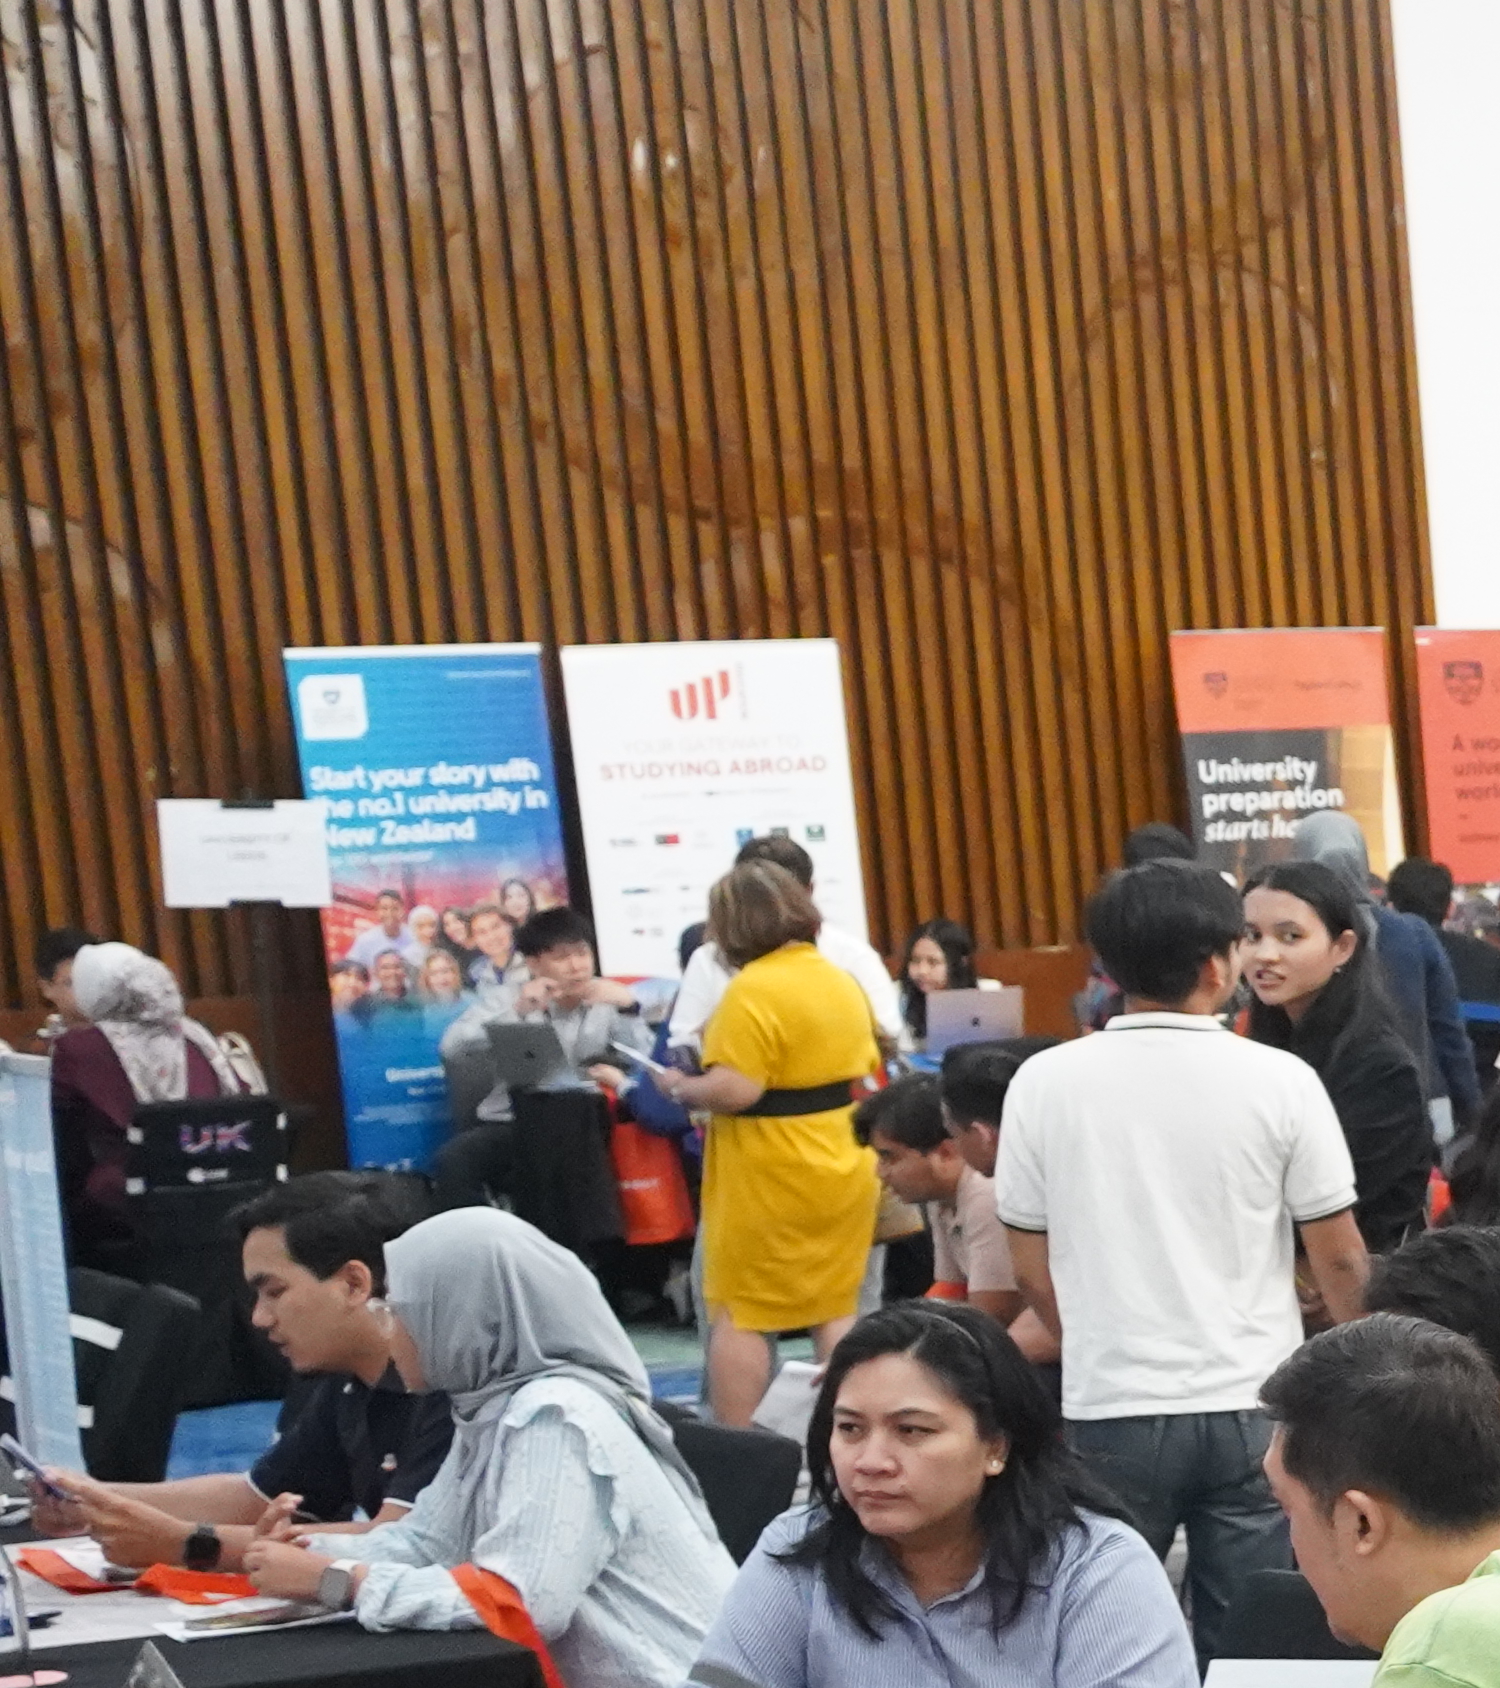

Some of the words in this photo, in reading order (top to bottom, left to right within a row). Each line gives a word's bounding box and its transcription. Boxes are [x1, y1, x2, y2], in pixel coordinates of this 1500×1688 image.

[668, 670, 731, 721] UP
[1453, 734, 1464, 751] A
[309, 765, 366, 791] Start
[369, 766, 425, 792] your
[429, 761, 486, 788] story
[488, 757, 540, 782] with
[599, 759, 721, 782] STUDYING
[728, 754, 829, 776] ABROAD
[1198, 755, 1318, 785] University
[357, 792, 404, 818] no.1
[408, 787, 522, 815] university
[524, 785, 548, 809] in
[1202, 784, 1344, 818] preparation
[380, 817, 476, 846] Zealand
[1204, 819, 1270, 843] starts
[179, 1120, 251, 1154] UK
